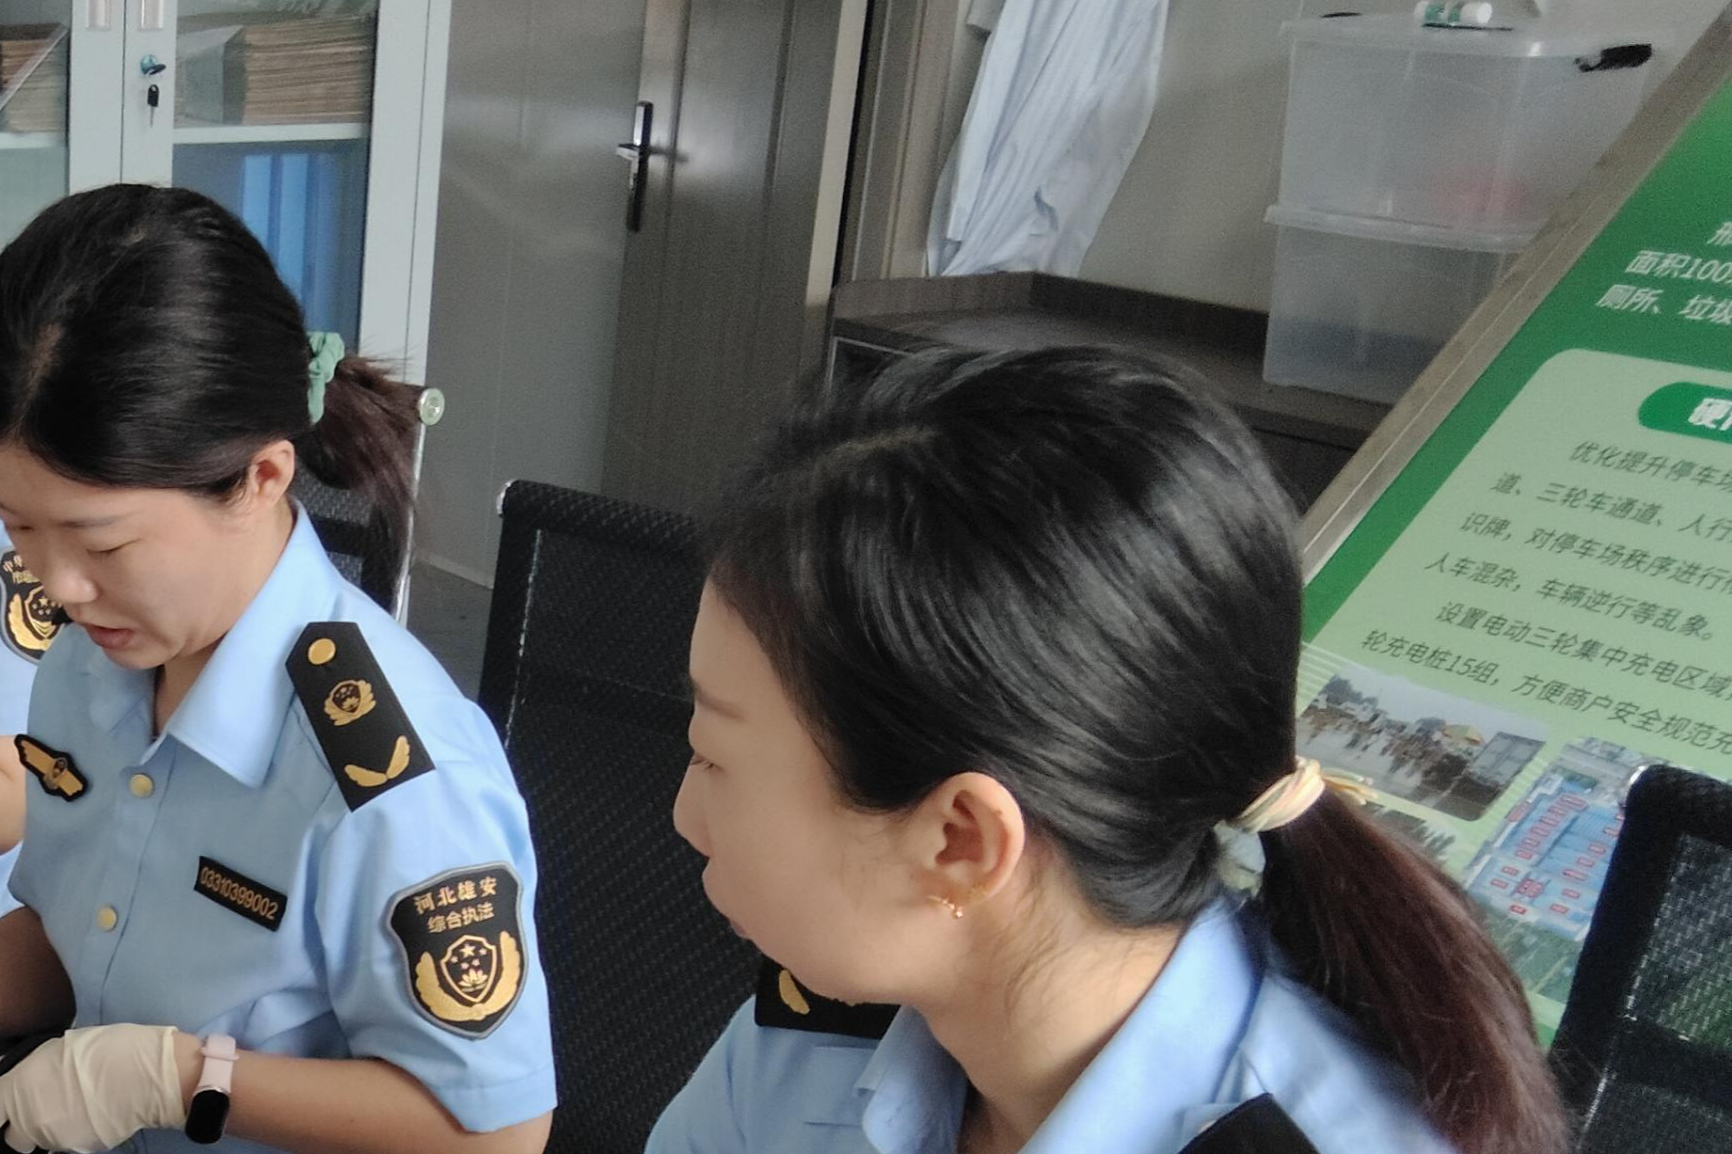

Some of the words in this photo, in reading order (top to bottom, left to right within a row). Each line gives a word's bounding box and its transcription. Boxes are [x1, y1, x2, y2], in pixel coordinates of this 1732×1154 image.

[1625, 249, 1732, 284] 面积100
[1424, 552, 1713, 641] 人车混杂，车辆逆行等乱象。
[1434, 600, 1732, 701] 设置电动三轮集中充电区域
[414, 876, 497, 914] 河北雄安
[427, 902, 495, 934] 综合执法
